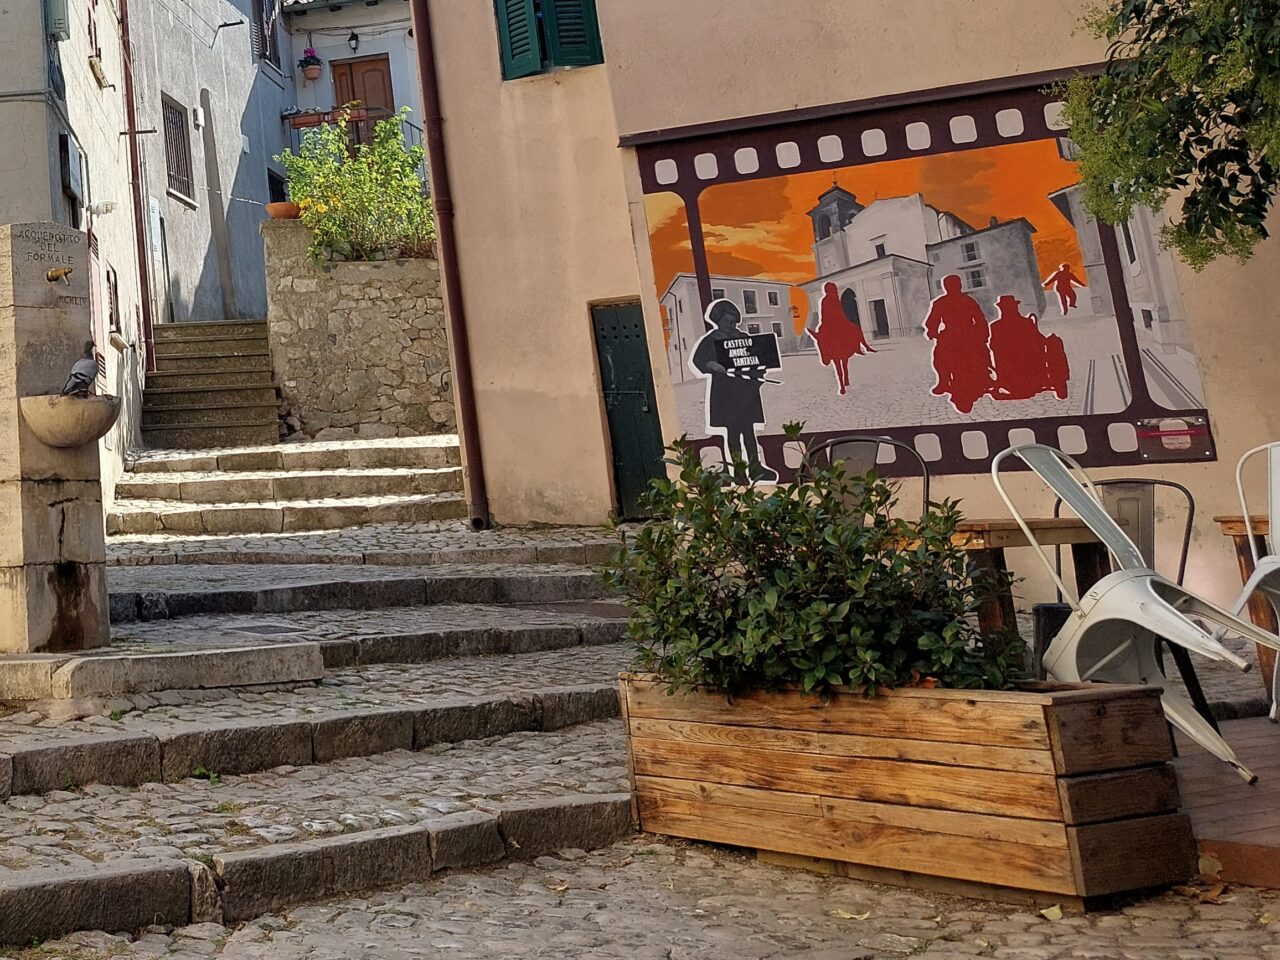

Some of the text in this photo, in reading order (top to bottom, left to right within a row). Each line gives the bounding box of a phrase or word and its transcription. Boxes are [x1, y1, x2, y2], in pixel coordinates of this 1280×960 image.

[18, 229, 81, 244] ACQUEDOTTO
[40, 243, 60, 253] DEL
[27, 251, 74, 265] FORMALE
[723, 338, 753, 349] CASTELLO
[733, 356, 760, 367] FANTASIA
